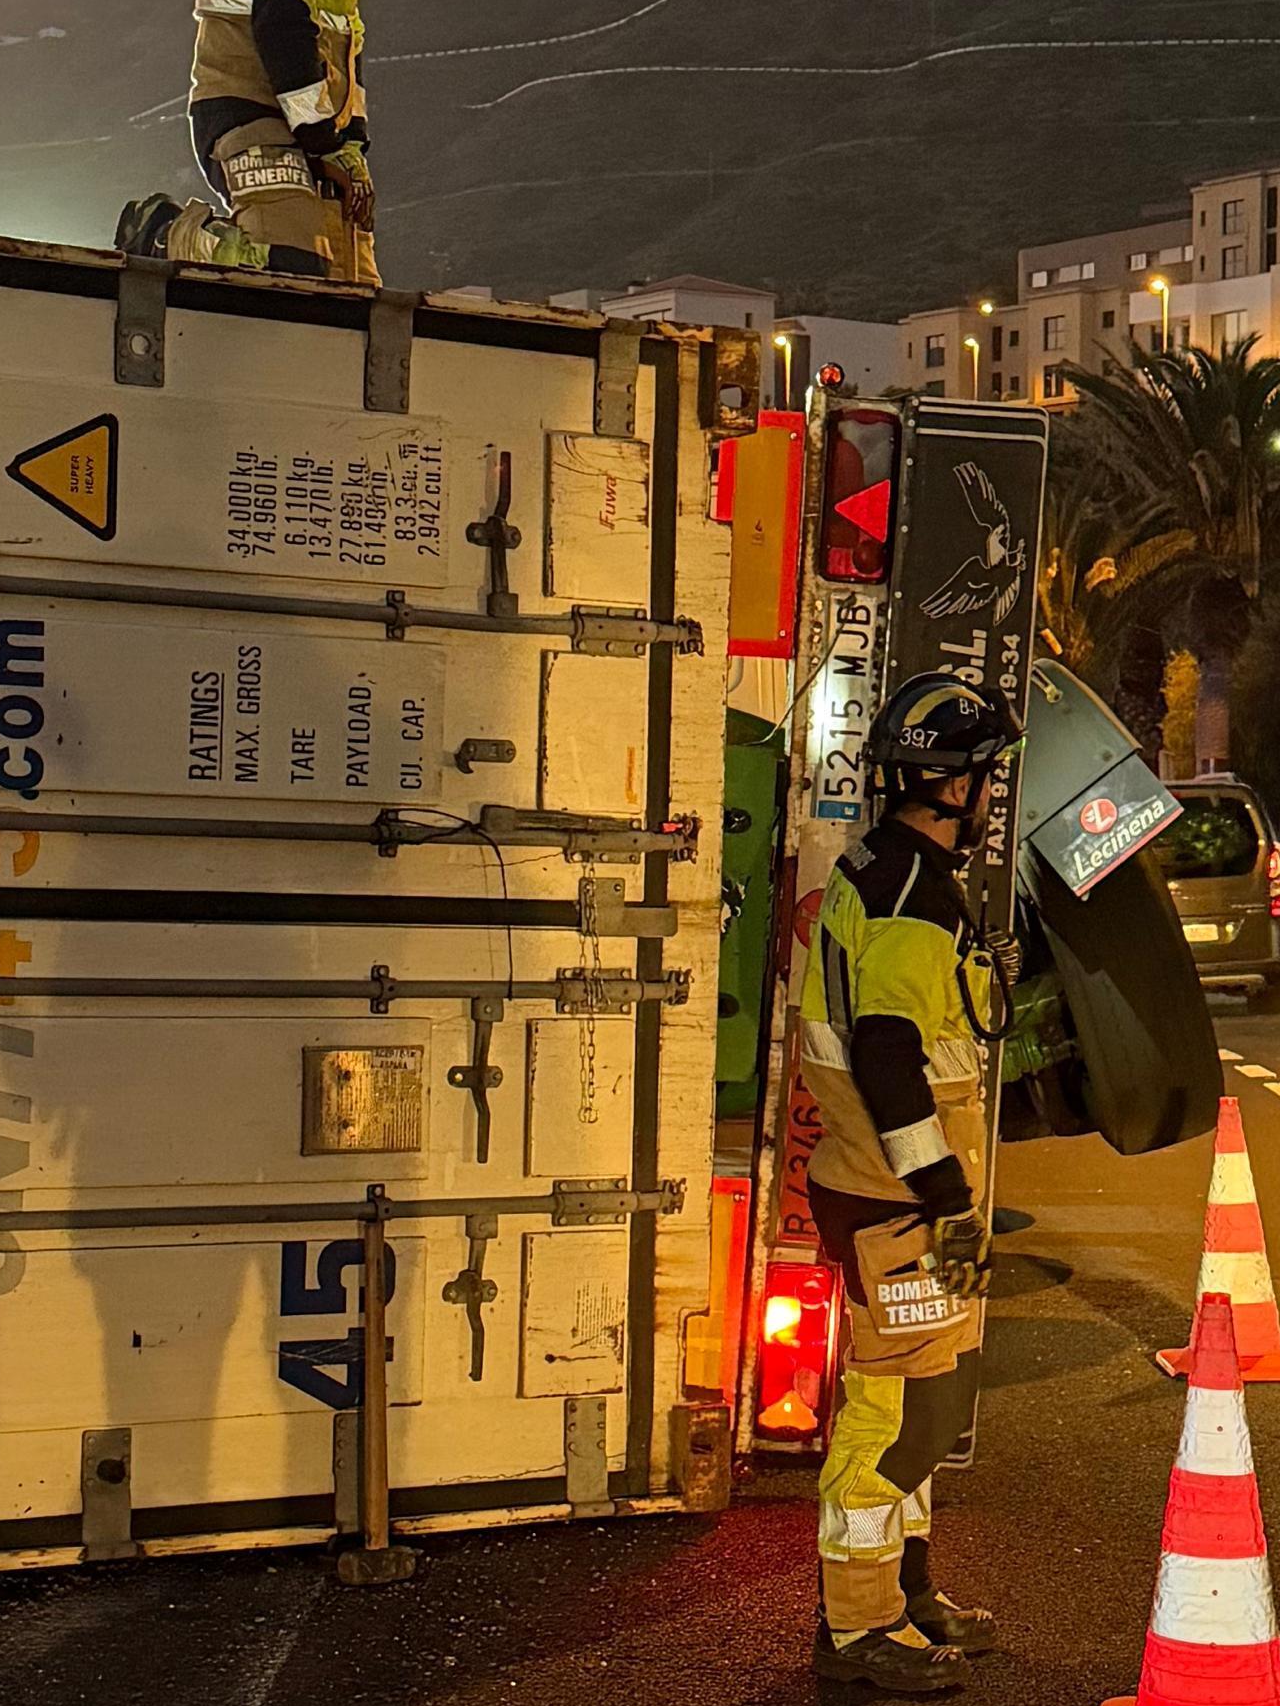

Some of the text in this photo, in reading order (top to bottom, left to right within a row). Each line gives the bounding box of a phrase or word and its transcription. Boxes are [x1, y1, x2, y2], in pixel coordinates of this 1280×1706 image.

[235, 167, 310, 188] TENERIFE
[70, 455, 80, 493] SUPER
[85, 455, 94, 494] HEAVY
[188, 671, 220, 780] RATINGS
[234, 645, 262, 782] MAX. GROSS
[401, 697, 425, 741] CAP.
[824, 600, 872, 796] 5215 MJB
[290, 727, 316, 784] TARE
[345, 686, 372, 787] PAYLOAD
[986, 806, 1008, 866] FAX:
[1073, 799, 1166, 881] Leciñena
[878, 1276, 944, 1303] BOMBE
[278, 1238, 396, 1411] 45
